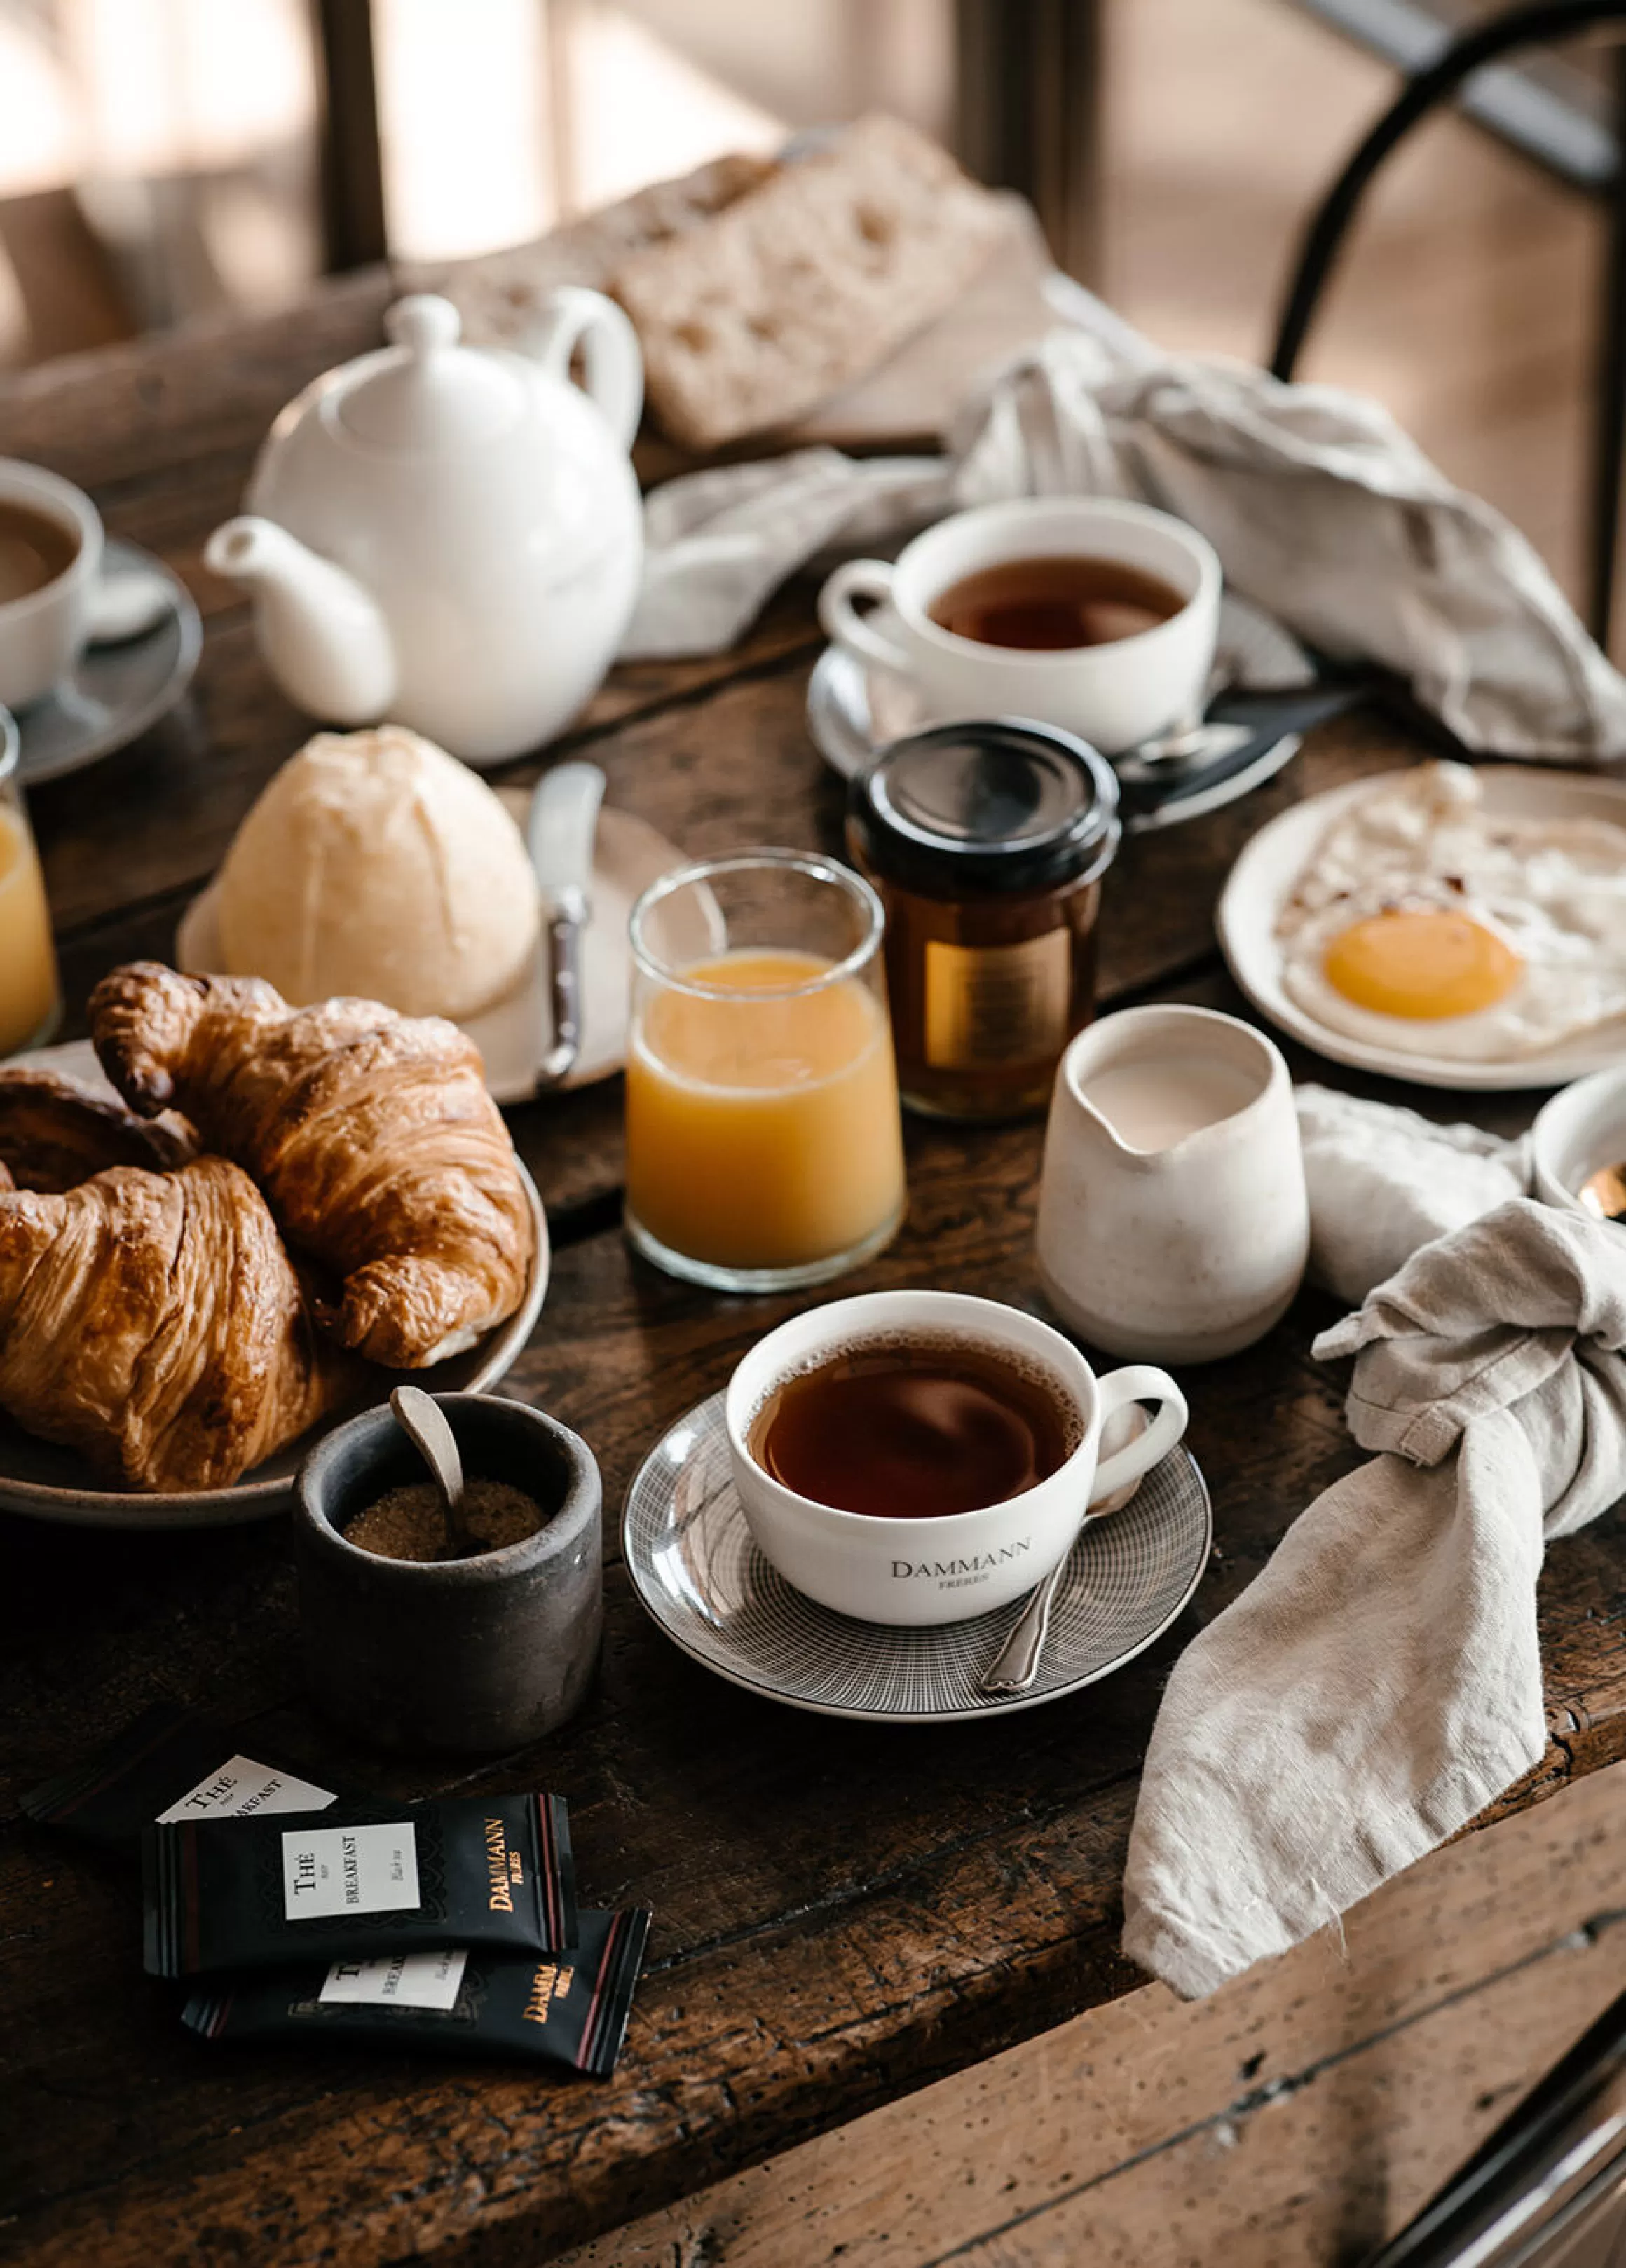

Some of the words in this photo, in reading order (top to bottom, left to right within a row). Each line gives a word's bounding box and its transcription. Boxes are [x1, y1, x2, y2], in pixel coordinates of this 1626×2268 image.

[891, 1536, 1032, 1579] DAMMANN
[342, 1836, 360, 1905] BREAKFAST
[484, 1817, 514, 1913] DAMMANN
